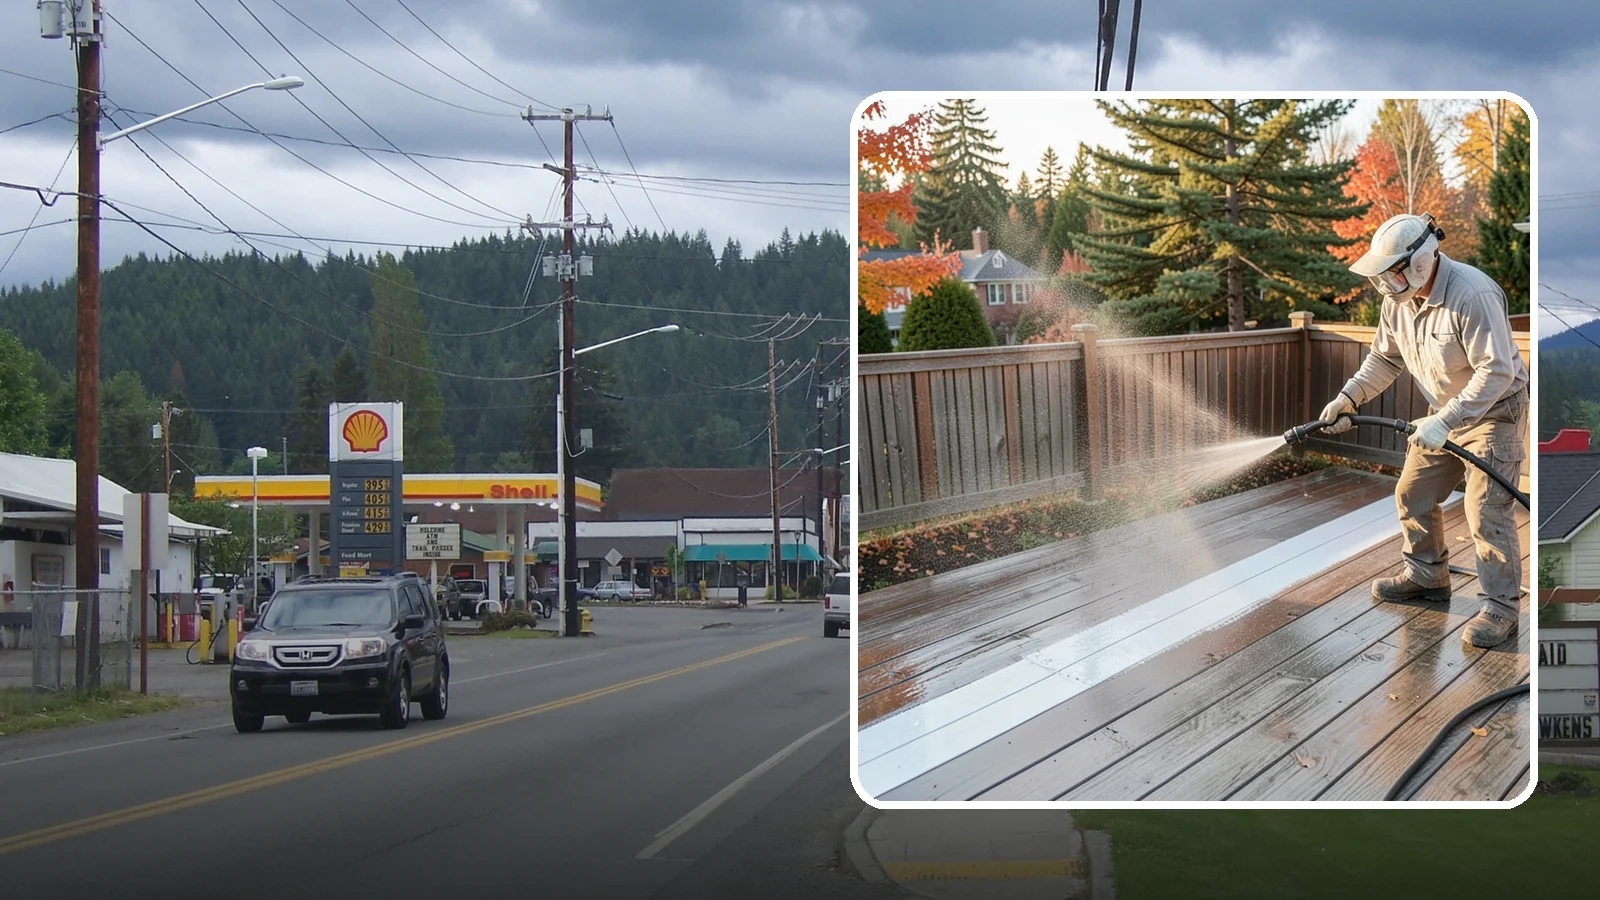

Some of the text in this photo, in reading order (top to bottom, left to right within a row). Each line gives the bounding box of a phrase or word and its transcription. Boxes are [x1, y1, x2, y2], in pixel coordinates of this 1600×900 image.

[366, 480, 383, 490] 395
[490, 484, 546, 499] Shell
[366, 494, 383, 504] 405
[366, 508, 383, 518] 415
[366, 522, 383, 532] 429
